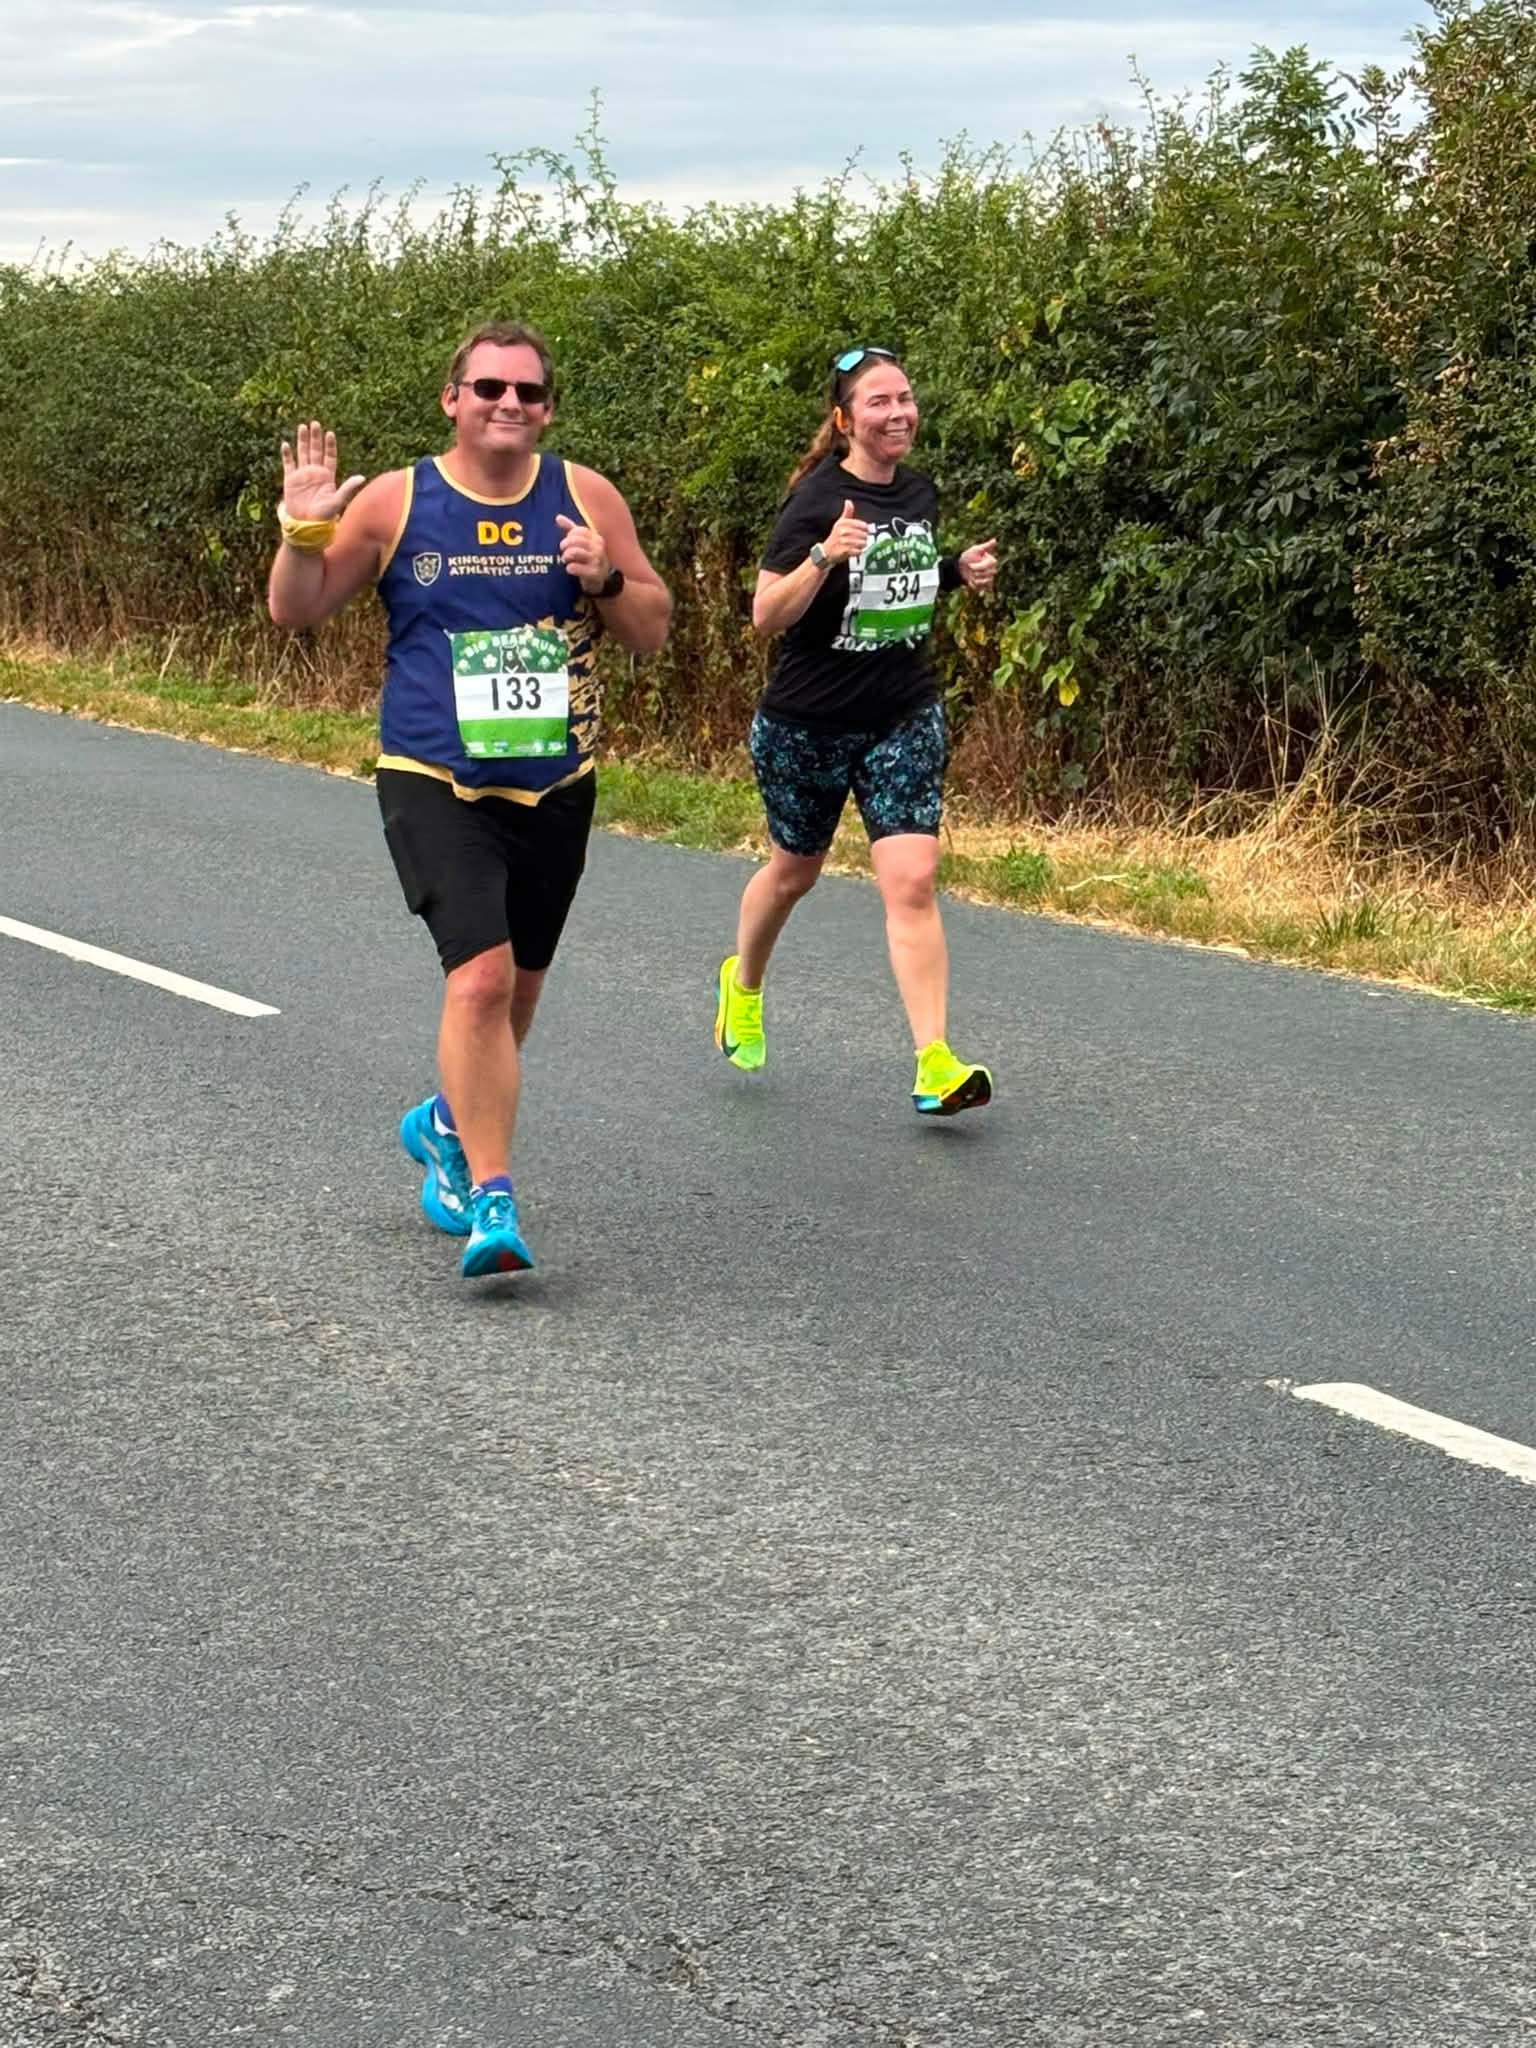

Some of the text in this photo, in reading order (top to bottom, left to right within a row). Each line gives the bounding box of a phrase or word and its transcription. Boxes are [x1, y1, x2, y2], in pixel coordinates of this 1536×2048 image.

[477, 521, 523, 546] DC
[448, 555, 514, 567] KINGSTON
[518, 555, 553, 565] UPON
[449, 565, 549, 576] ATHLETIC CLUB
[883, 574, 920, 605] 534
[490, 677, 542, 711] 133
